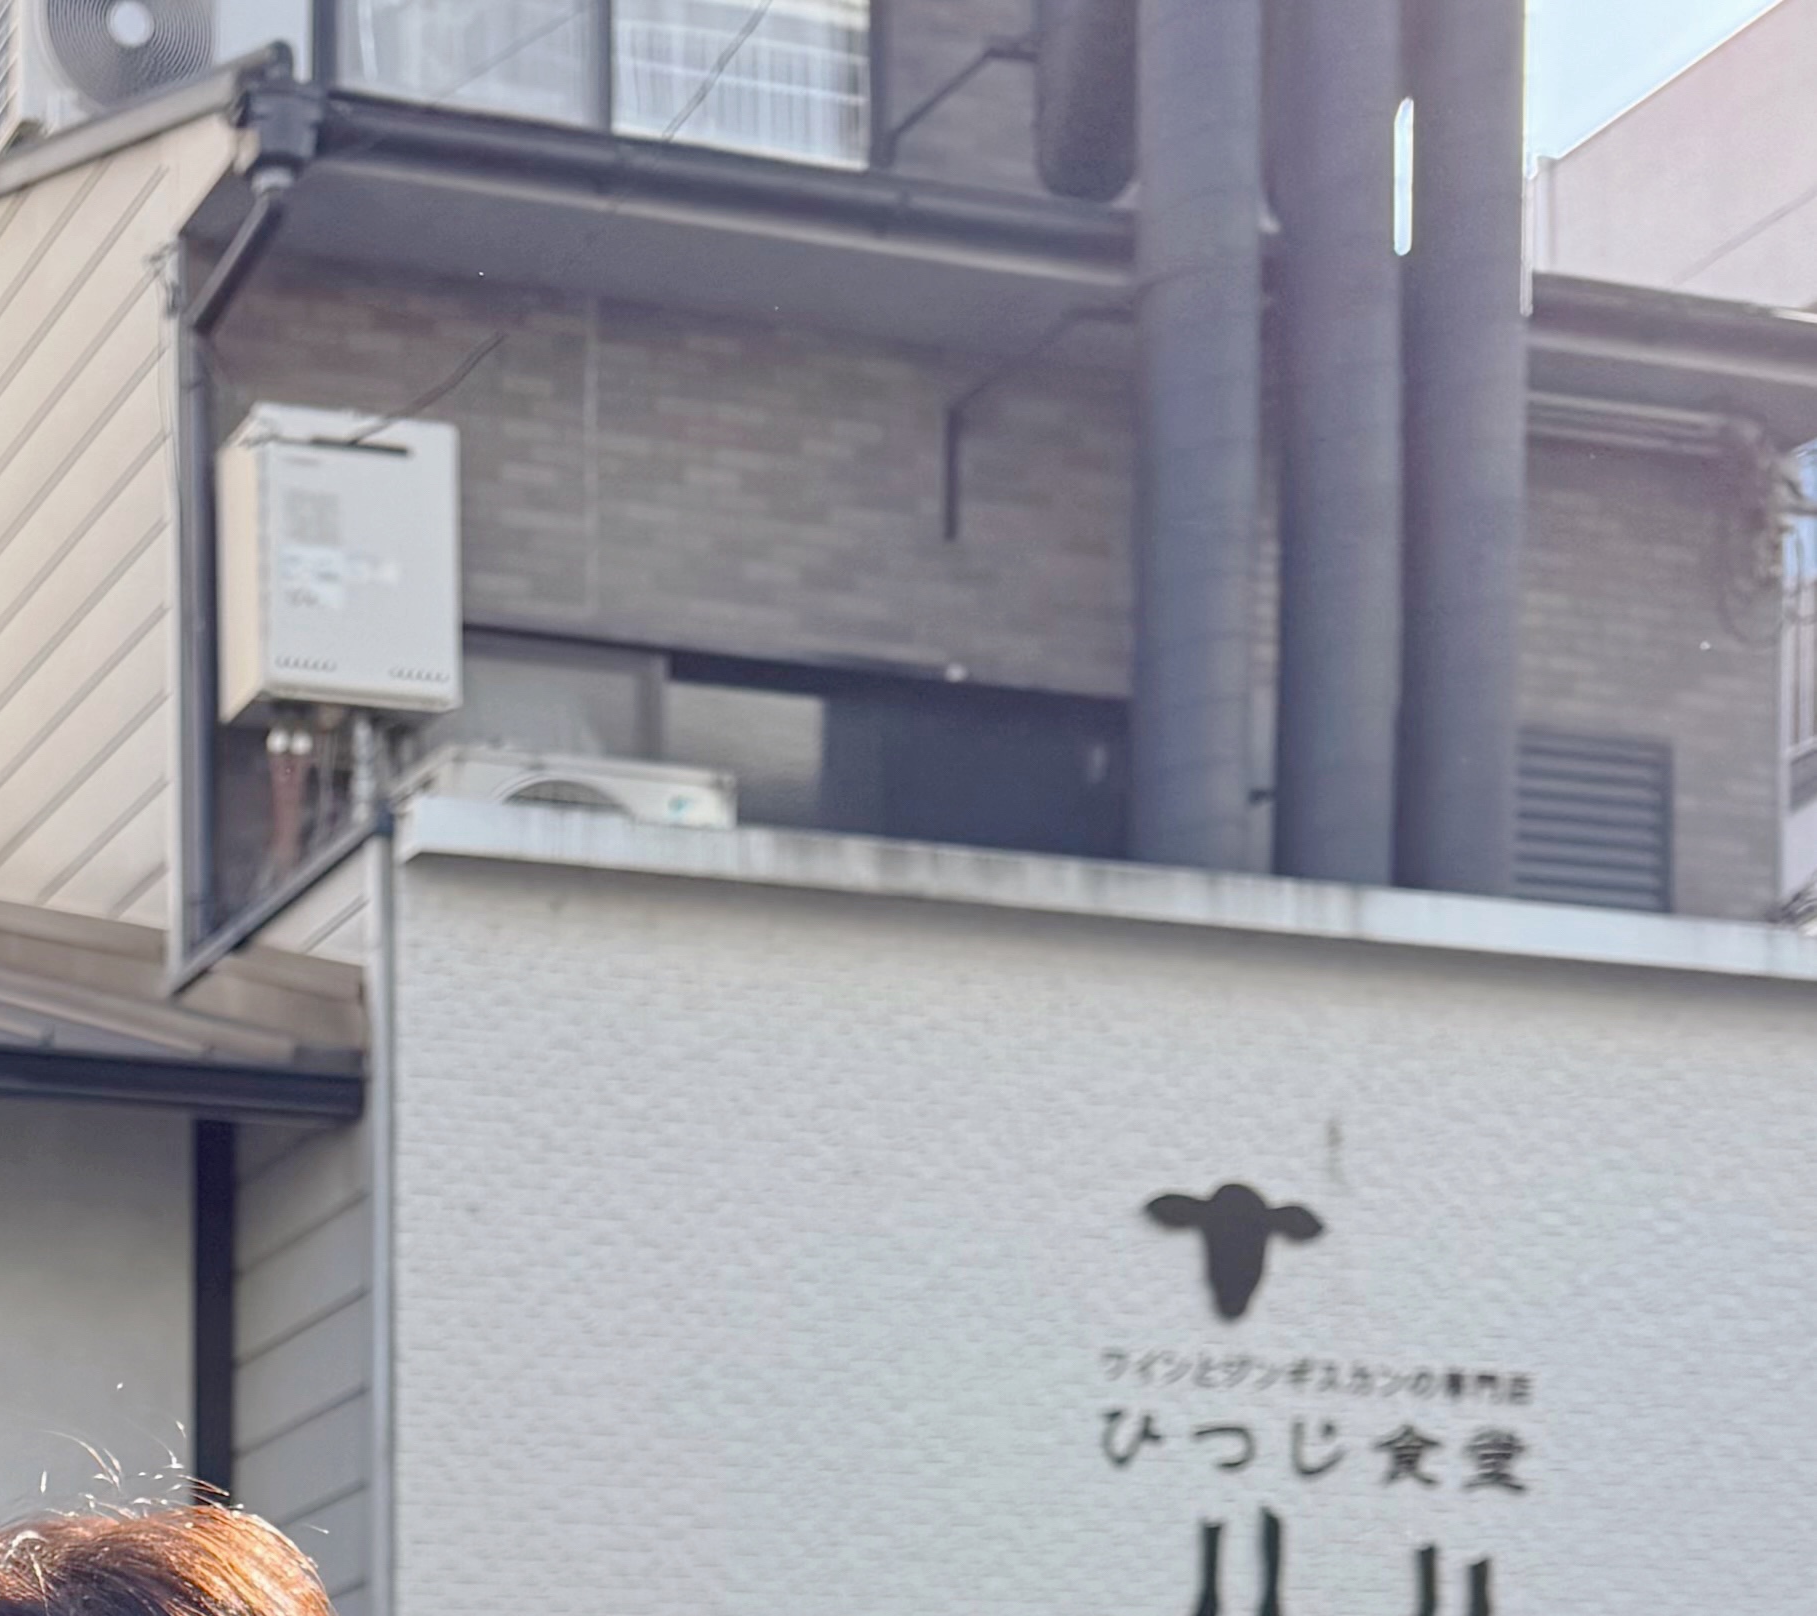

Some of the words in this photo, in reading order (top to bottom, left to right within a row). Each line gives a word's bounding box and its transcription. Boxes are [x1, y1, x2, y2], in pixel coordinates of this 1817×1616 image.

[1101, 1408, 1527, 1493] ひつじ食堂
